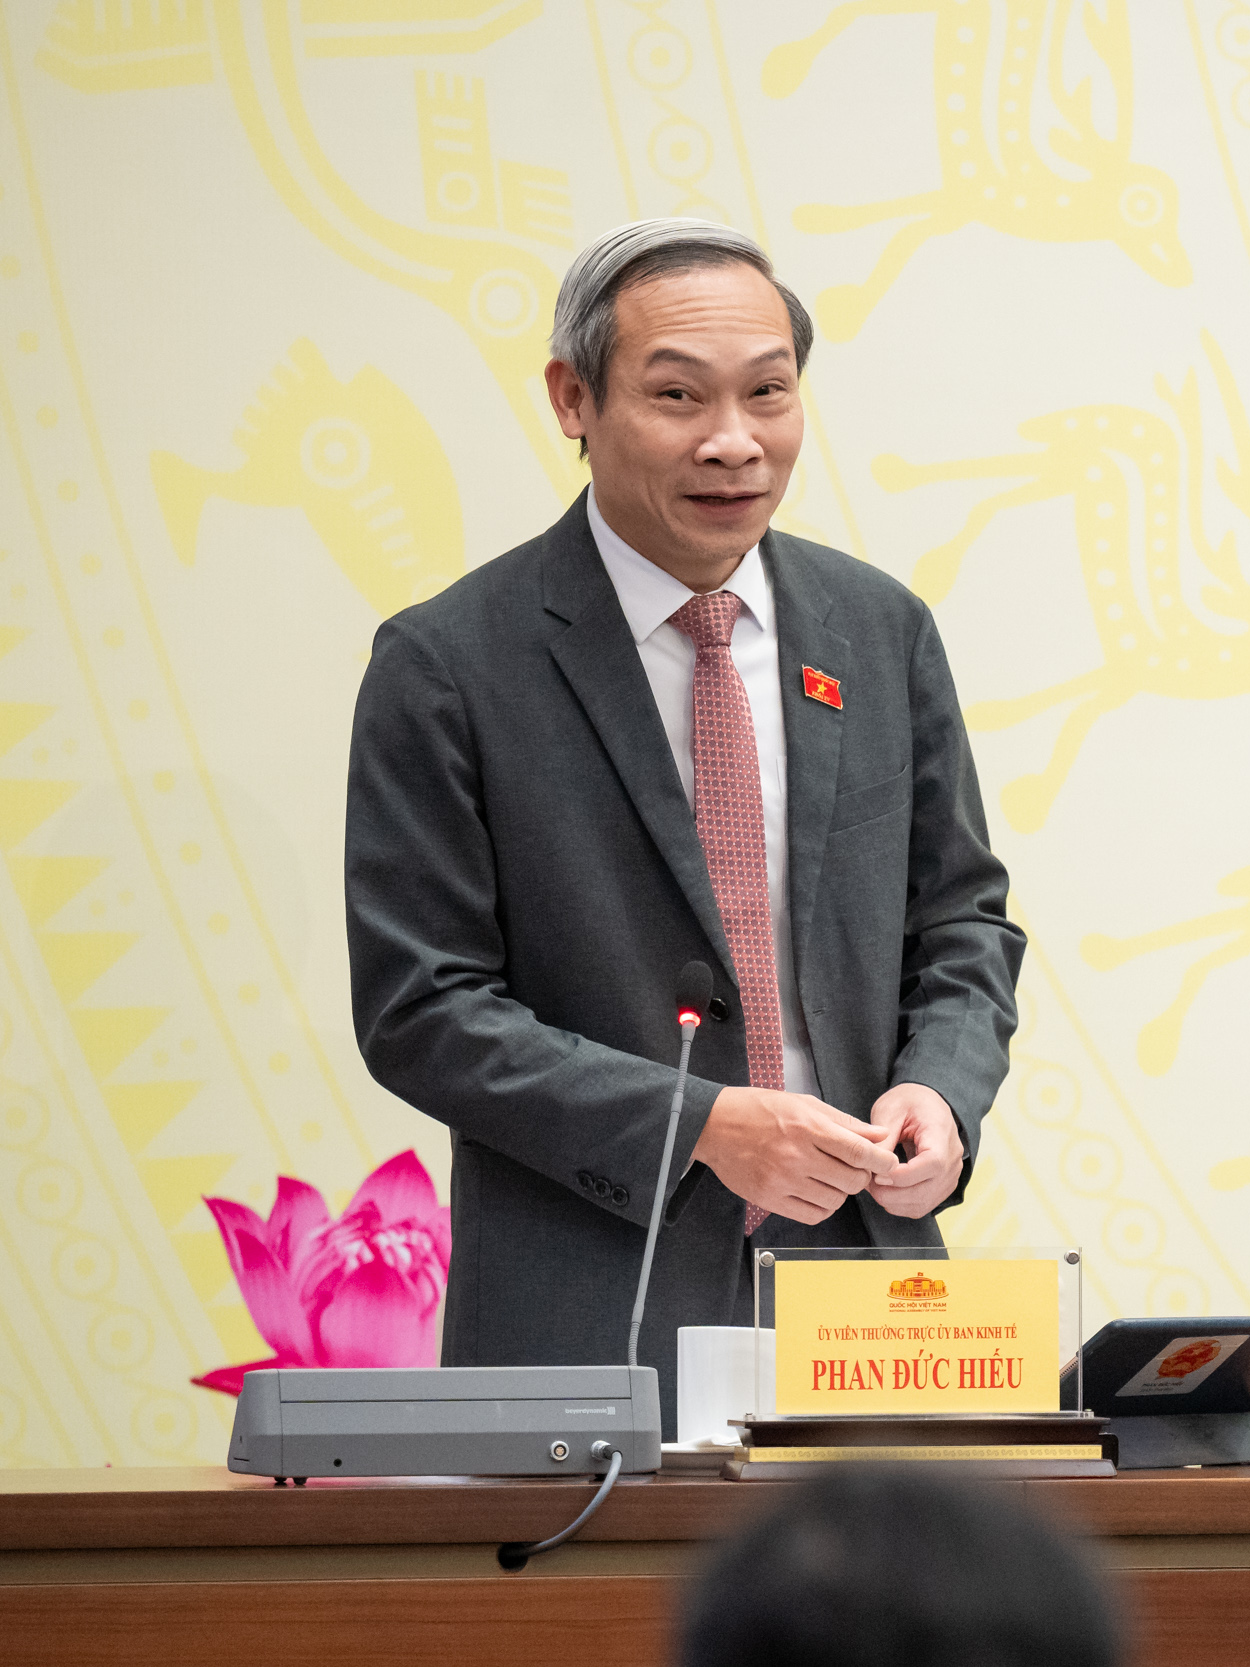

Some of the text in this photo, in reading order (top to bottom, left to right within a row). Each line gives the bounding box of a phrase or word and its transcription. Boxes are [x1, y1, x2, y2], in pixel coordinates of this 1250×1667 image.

[818, 1322, 1018, 1343] ỦY VIÊN THƯỜNG TRỰC ỦY BAN KINH TẾ
[811, 1347, 1024, 1391] PHAN ĐỨC HIẾU
